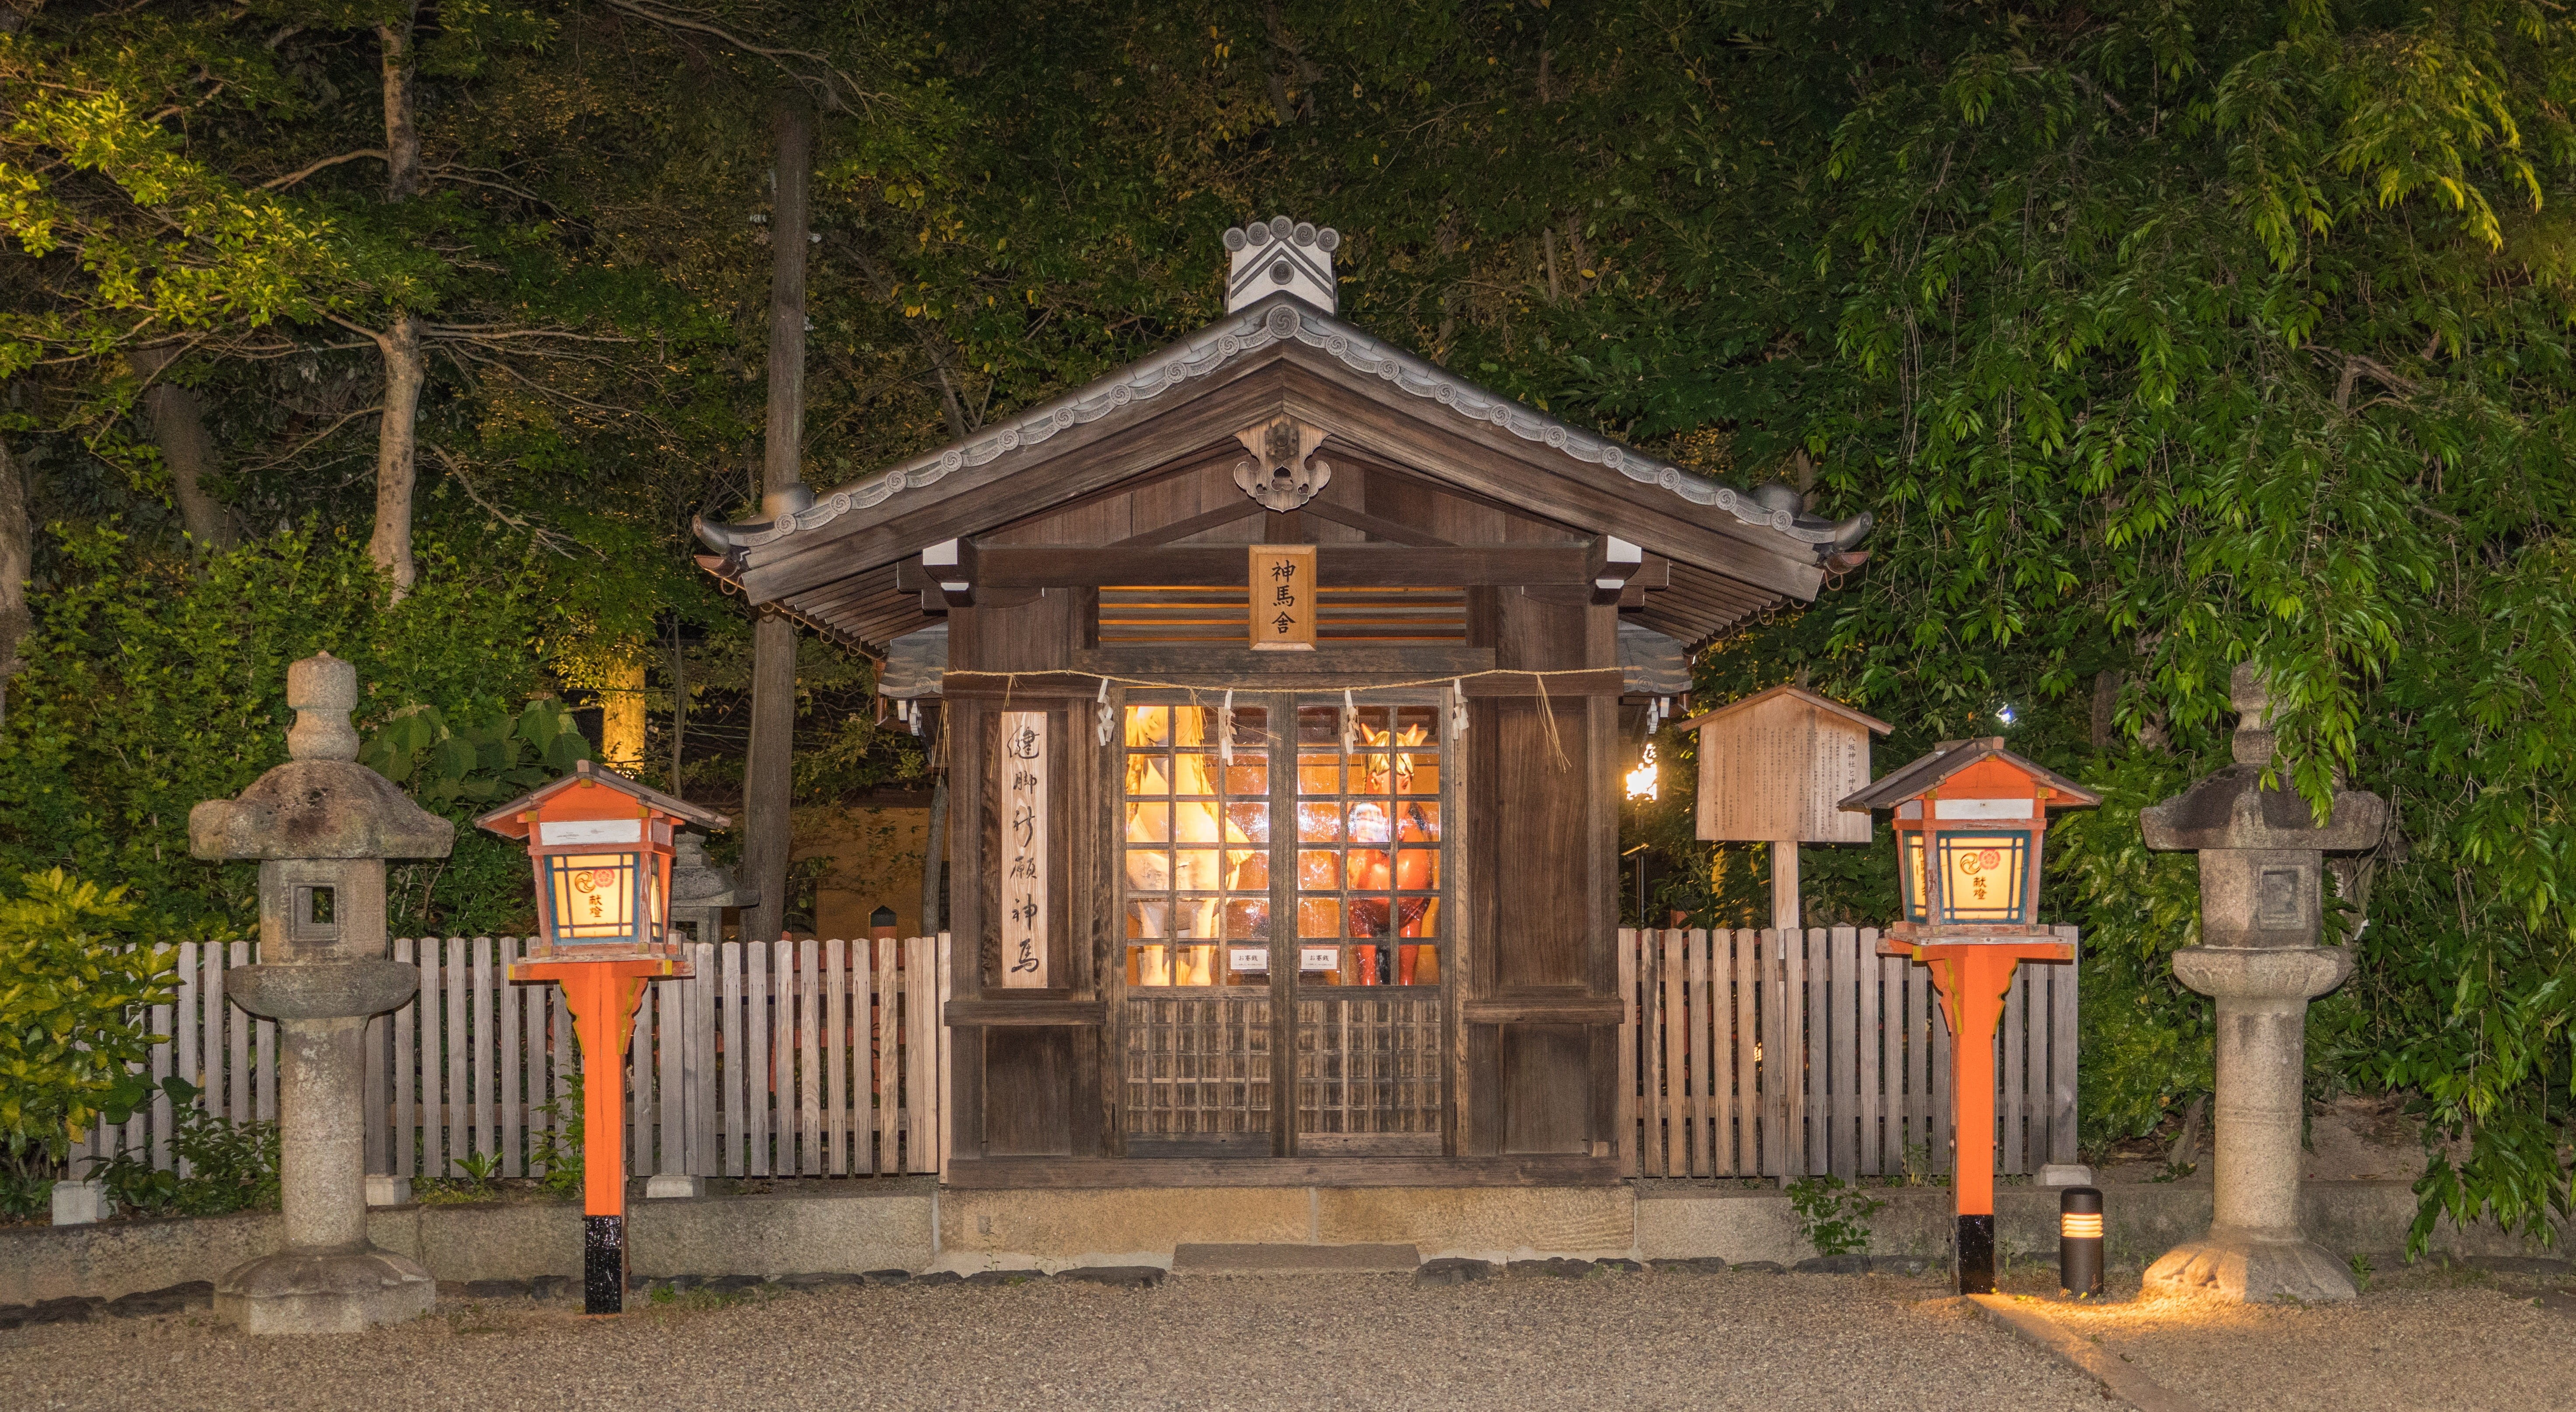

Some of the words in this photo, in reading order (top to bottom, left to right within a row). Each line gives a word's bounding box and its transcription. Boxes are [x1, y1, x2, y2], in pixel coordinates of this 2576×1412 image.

[1271, 559, 1297, 634] 神馬舎
[1847, 735, 1856, 794] 八坂神社と神馬
[1007, 725, 1040, 974] 健脚祈願神馬
